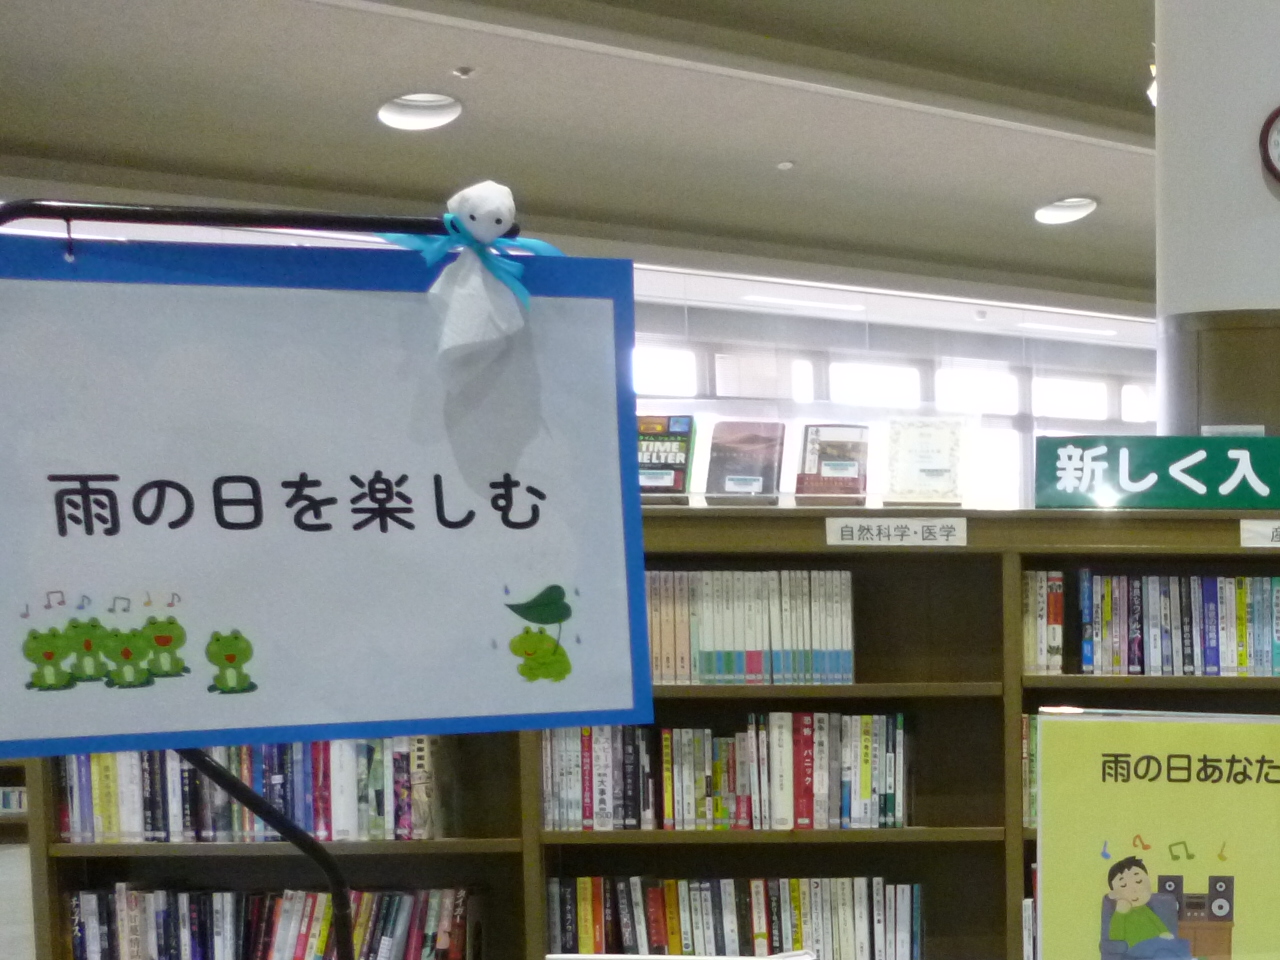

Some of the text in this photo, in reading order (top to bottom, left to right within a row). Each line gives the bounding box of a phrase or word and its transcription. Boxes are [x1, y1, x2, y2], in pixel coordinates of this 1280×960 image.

[47, 470, 547, 537] 雨の日を楽しむ
[839, 524, 957, 542] 自然科学・医学
